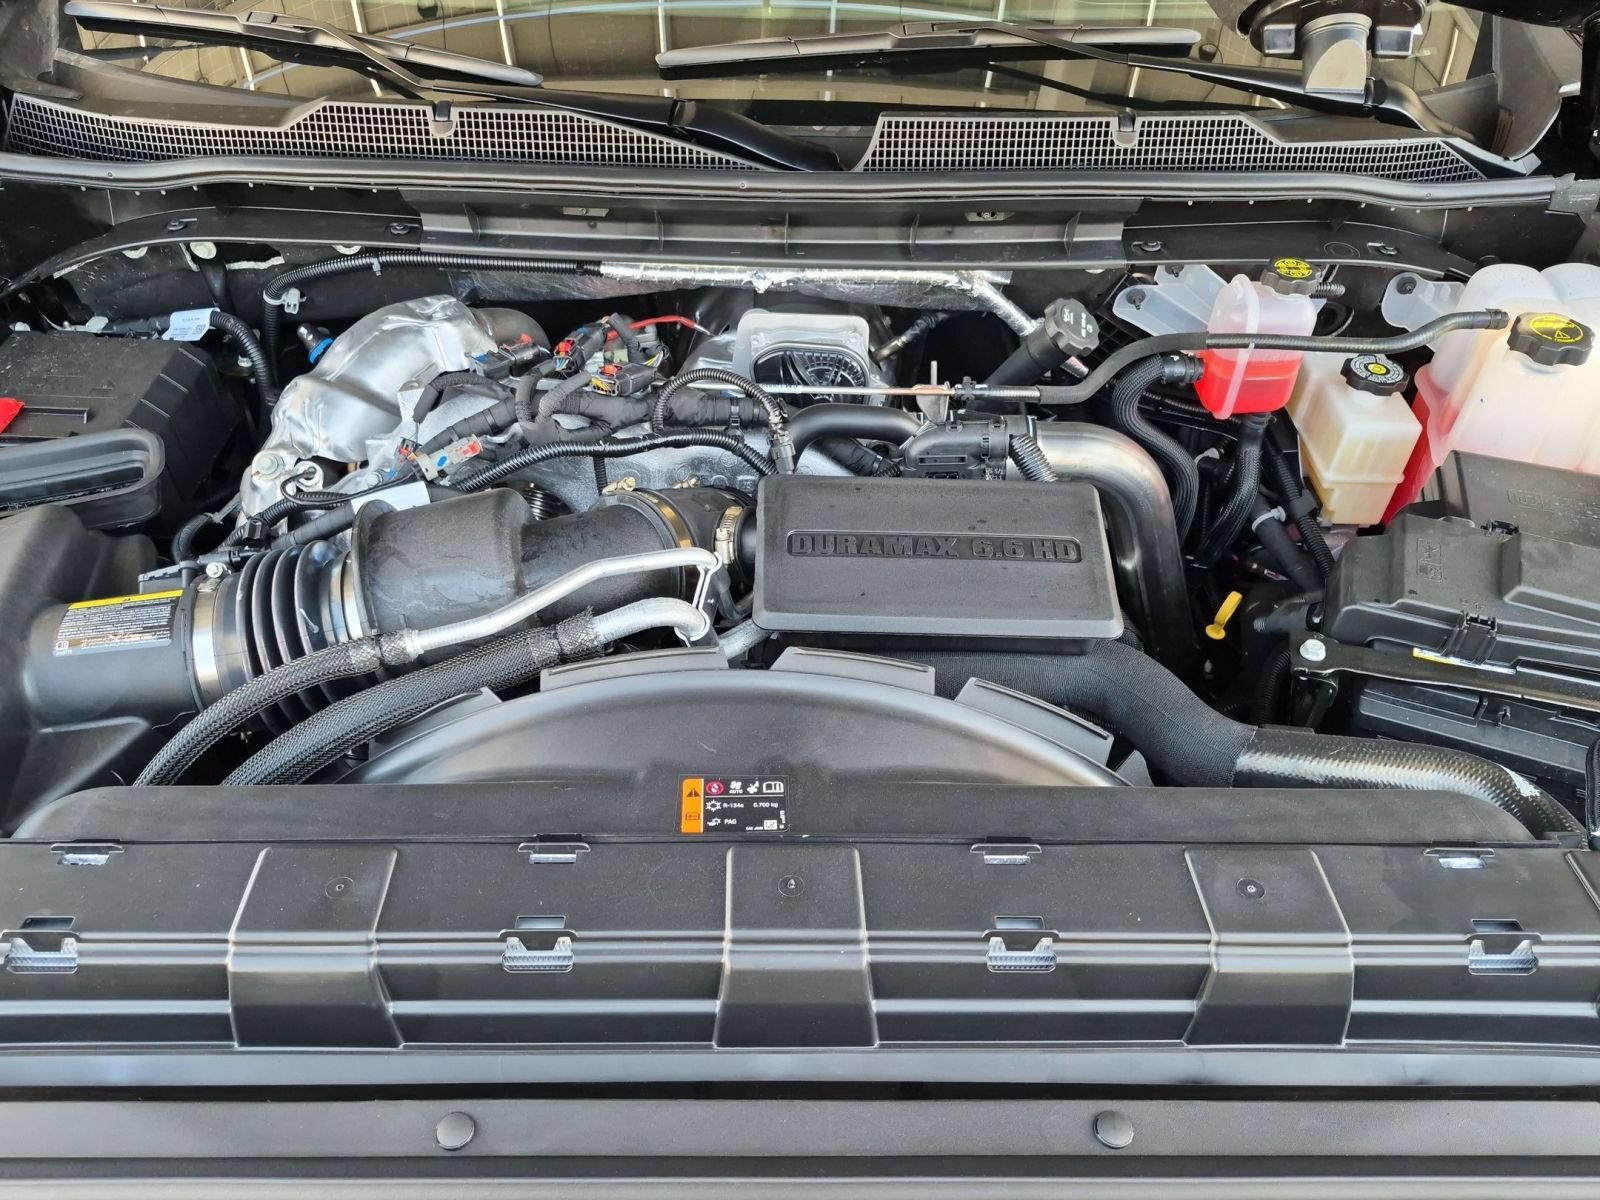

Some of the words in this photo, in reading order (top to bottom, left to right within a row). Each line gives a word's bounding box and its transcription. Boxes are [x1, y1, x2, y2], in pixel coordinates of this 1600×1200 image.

[791, 534, 959, 558] DURAMAX
[971, 538, 1025, 559] 6.6
[1031, 539, 1078, 561] HD
